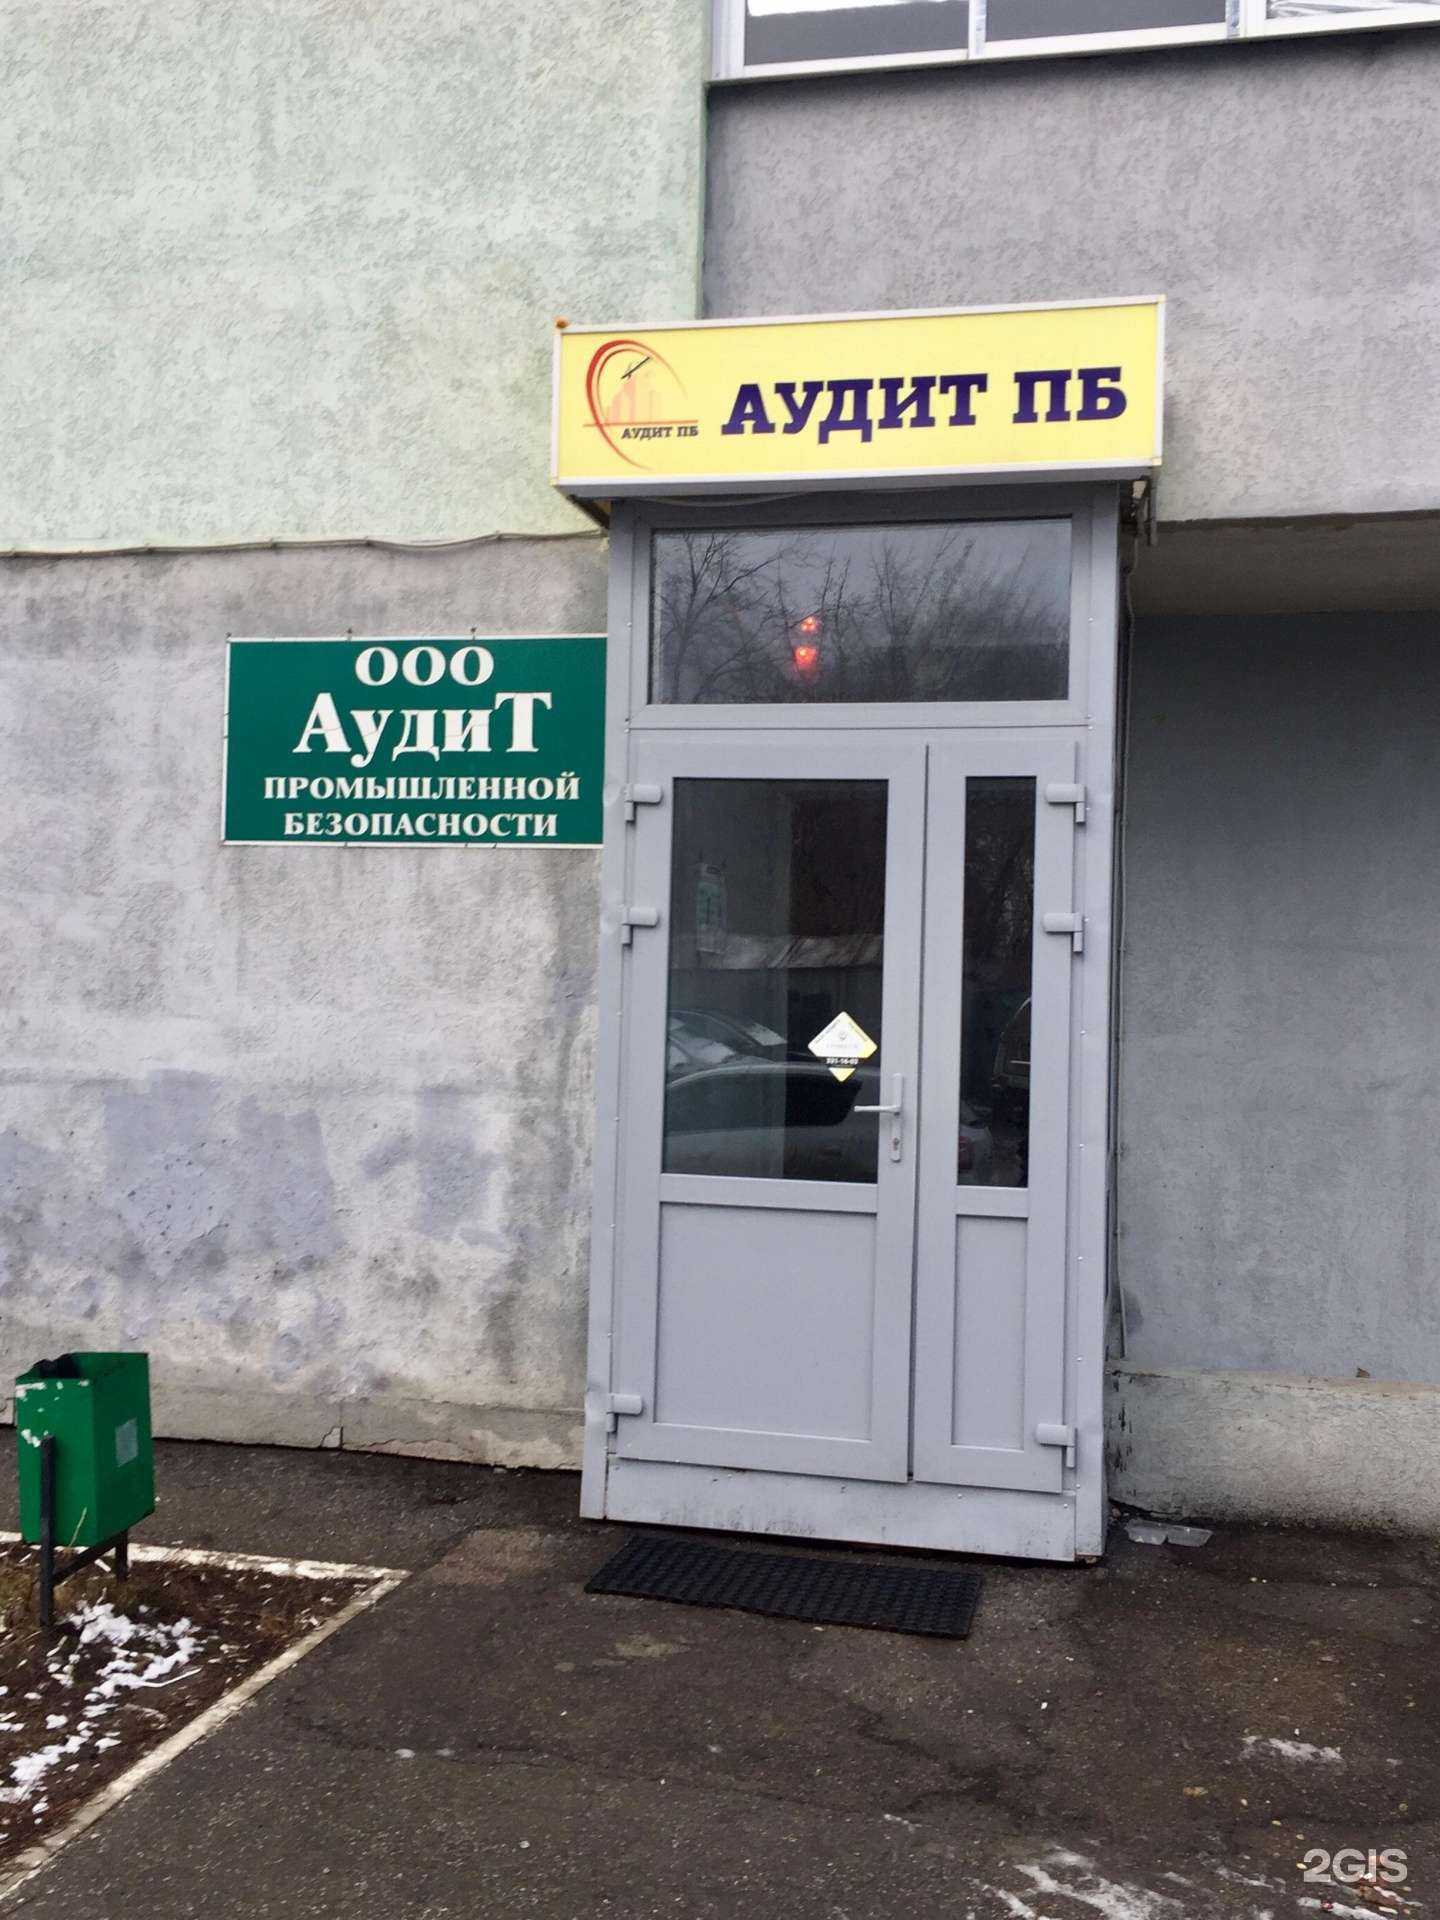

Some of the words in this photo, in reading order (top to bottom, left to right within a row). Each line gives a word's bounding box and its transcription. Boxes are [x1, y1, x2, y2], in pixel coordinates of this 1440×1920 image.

[721, 373, 988, 444] АУДИТ
[1012, 366, 1128, 423] ПБ
[621, 426, 673, 440] АУДИТ
[676, 425, 699, 438] ПБ
[354, 646, 495, 686] ООО
[263, 771, 580, 800] ПРОМЫШЛЕННОЙ
[283, 812, 558, 837] БЕЗОПАСНОСТИ
